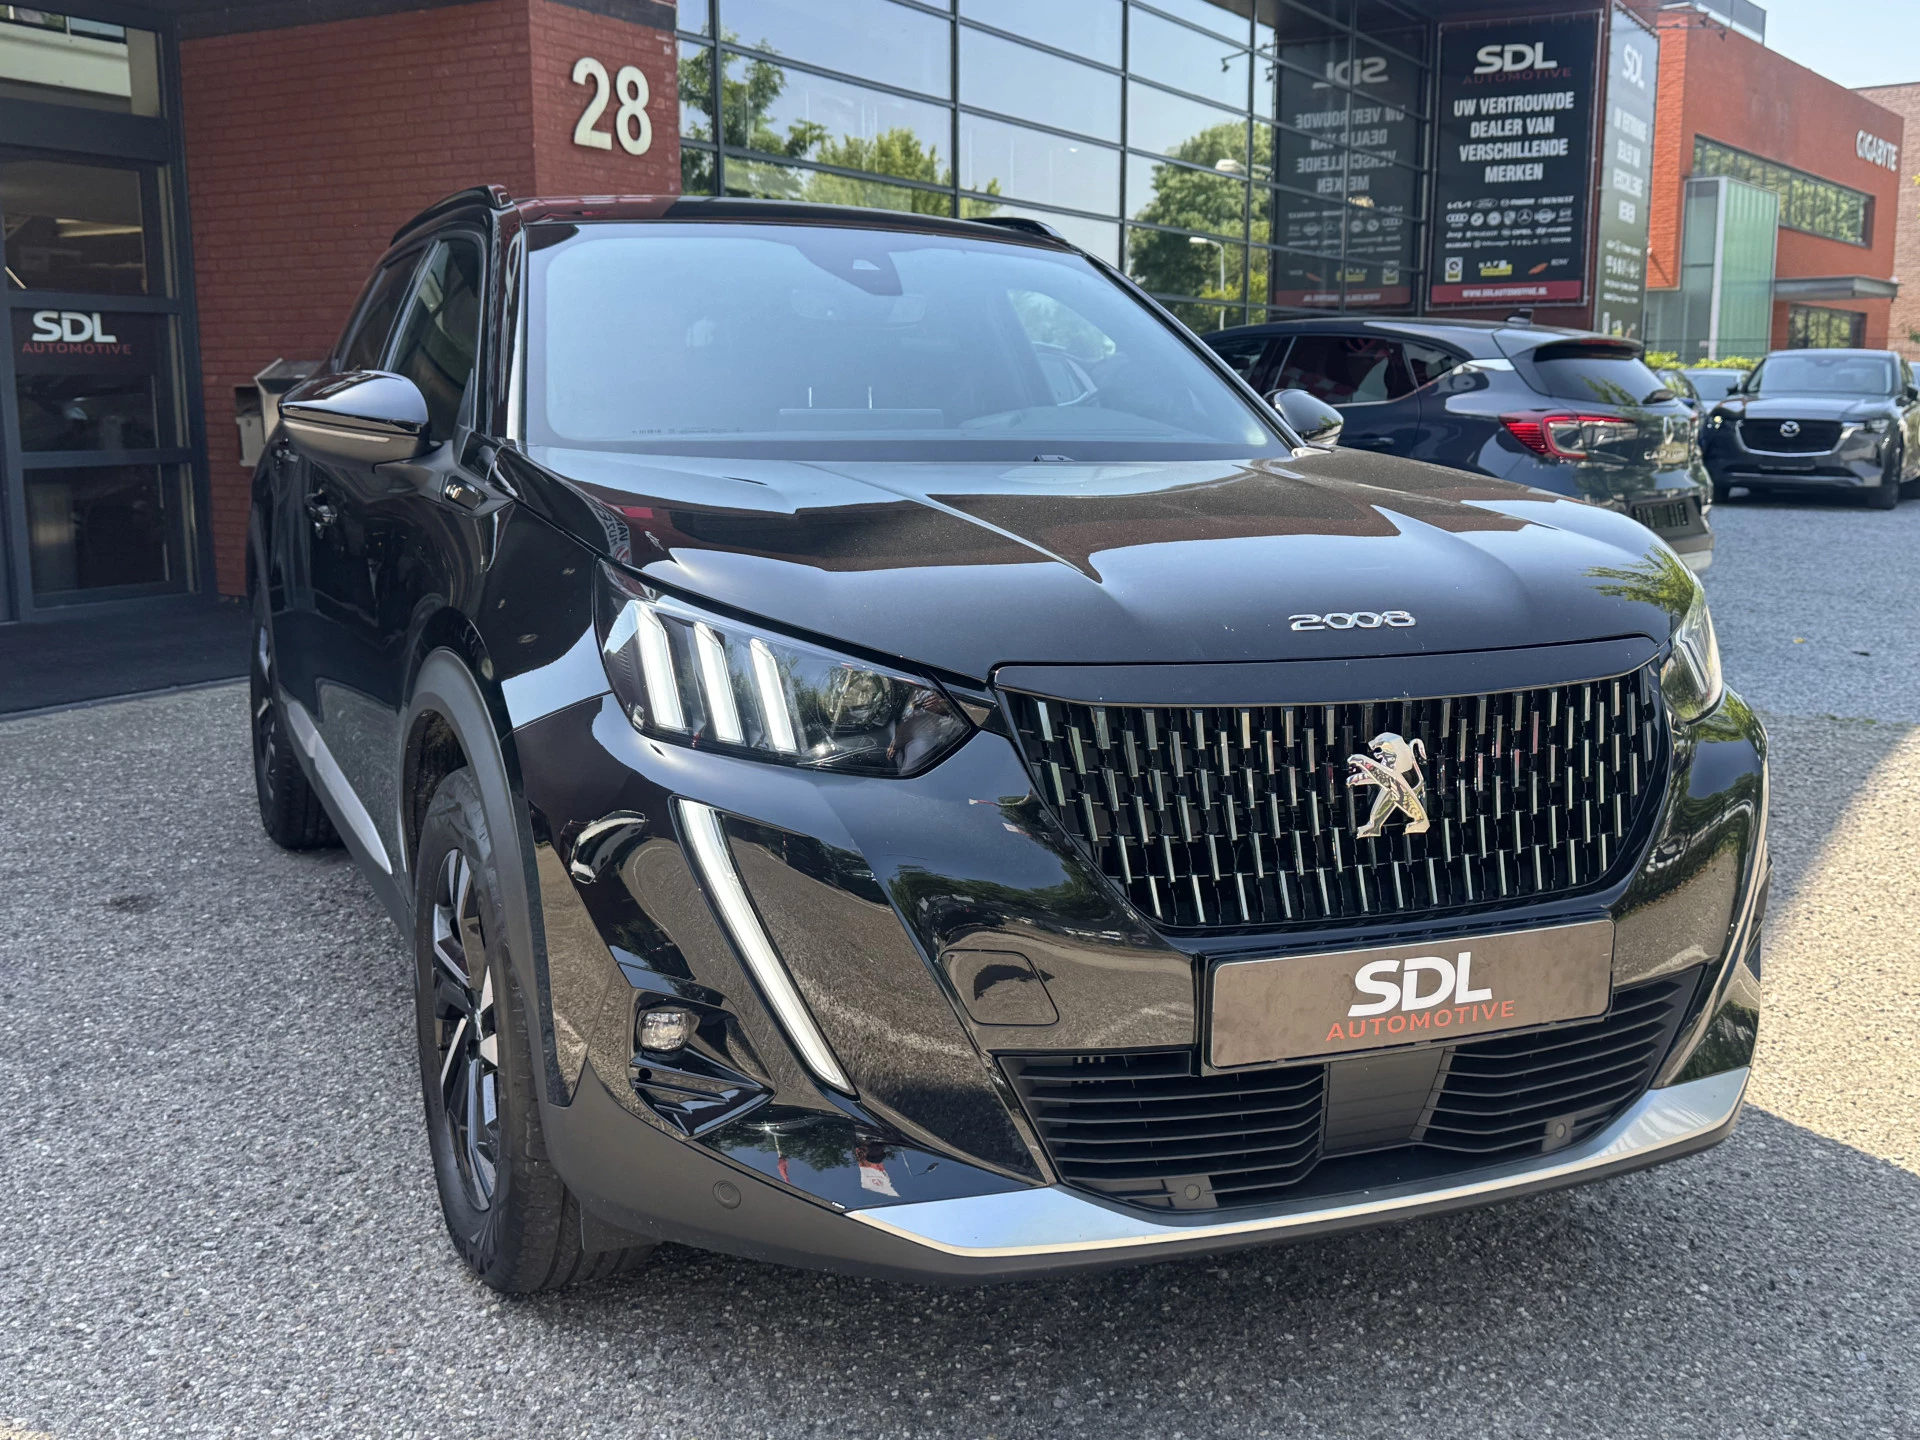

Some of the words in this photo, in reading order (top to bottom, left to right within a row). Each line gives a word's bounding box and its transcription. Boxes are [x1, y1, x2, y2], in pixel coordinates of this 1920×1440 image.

[1473, 42, 1558, 74] SDL
[1622, 43, 1645, 90] SDL
[1462, 67, 1573, 85] AUTOMOTIVE
[572, 57, 652, 156] 28
[1453, 99, 1477, 117] UW
[1479, 91, 1575, 115] VERTROUWDE
[1470, 118, 1523, 139] DEALER
[1526, 116, 1556, 135] VAN
[1459, 138, 1569, 162] VERSCHILLENDE
[1856, 129, 1898, 172] GIGABYTE
[1485, 163, 1544, 183] MERKEN
[31, 311, 118, 343] SDL
[22, 342, 132, 356] AUTOMOTIVE
[1288, 610, 1416, 631] 2008
[1347, 951, 1493, 1017] SDL
[1325, 1000, 1515, 1042] AUTOMOTIVE
